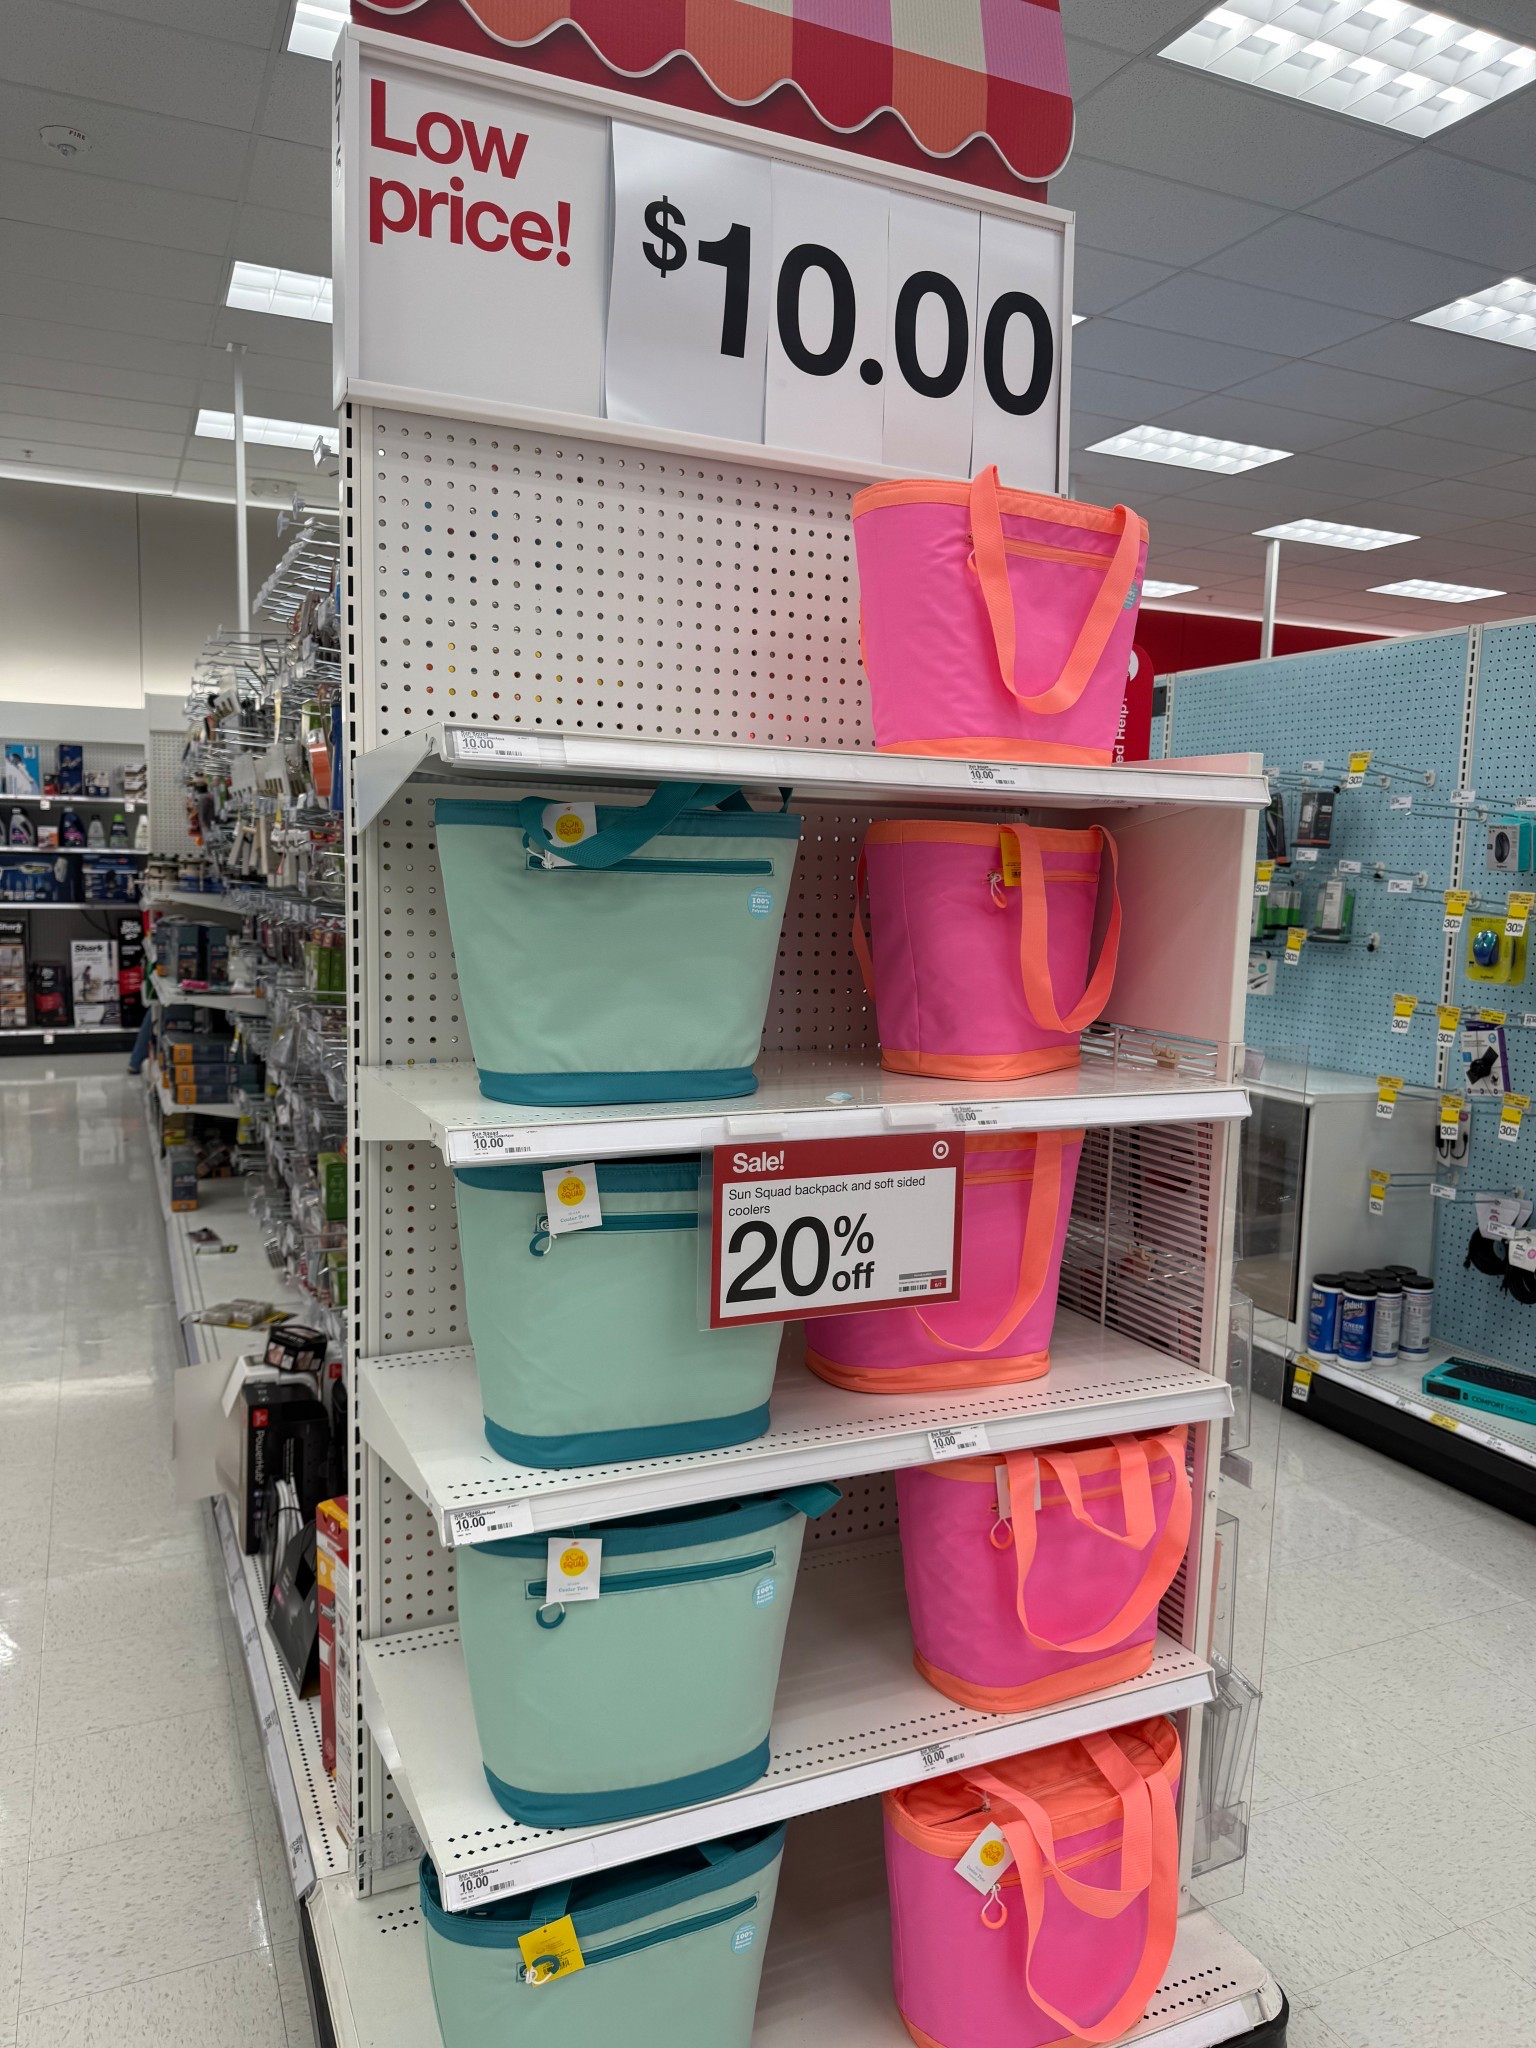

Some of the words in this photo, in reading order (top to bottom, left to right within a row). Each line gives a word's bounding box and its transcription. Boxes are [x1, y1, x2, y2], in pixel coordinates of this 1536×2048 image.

[370, 79, 529, 180] Low
[369, 177, 571, 267] price!
[642, 195, 1054, 416] $10.00
[462, 738, 494, 749] 10.00
[971, 770, 993, 779] 10.00
[559, 828, 582, 836] SQUAD
[75, 944, 104, 953] Shark
[473, 1138, 504, 1149] 10.00
[732, 1150, 785, 1174] Sale!
[561, 1189, 583, 1199] SQUAD
[728, 1188, 751, 1201] Sun
[755, 1186, 792, 1202] Squad
[795, 1181, 848, 1196] backpack
[851, 1179, 872, 1192] and
[874, 1177, 894, 1189] soft
[897, 1175, 926, 1188] sided
[728, 1204, 771, 1217] coolers
[725, 1213, 874, 1304] 20%
[832, 1261, 875, 1292] off
[1471, 1395, 1504, 1409] COMFORT
[933, 1436, 956, 1448] 10.00
[254, 1430, 265, 1482] PowerHub
[456, 1516, 486, 1531] 10.00
[563, 1560, 585, 1569] SQUAD
[922, 1750, 945, 1766] 10.00
[459, 1875, 489, 1893] 10.00
